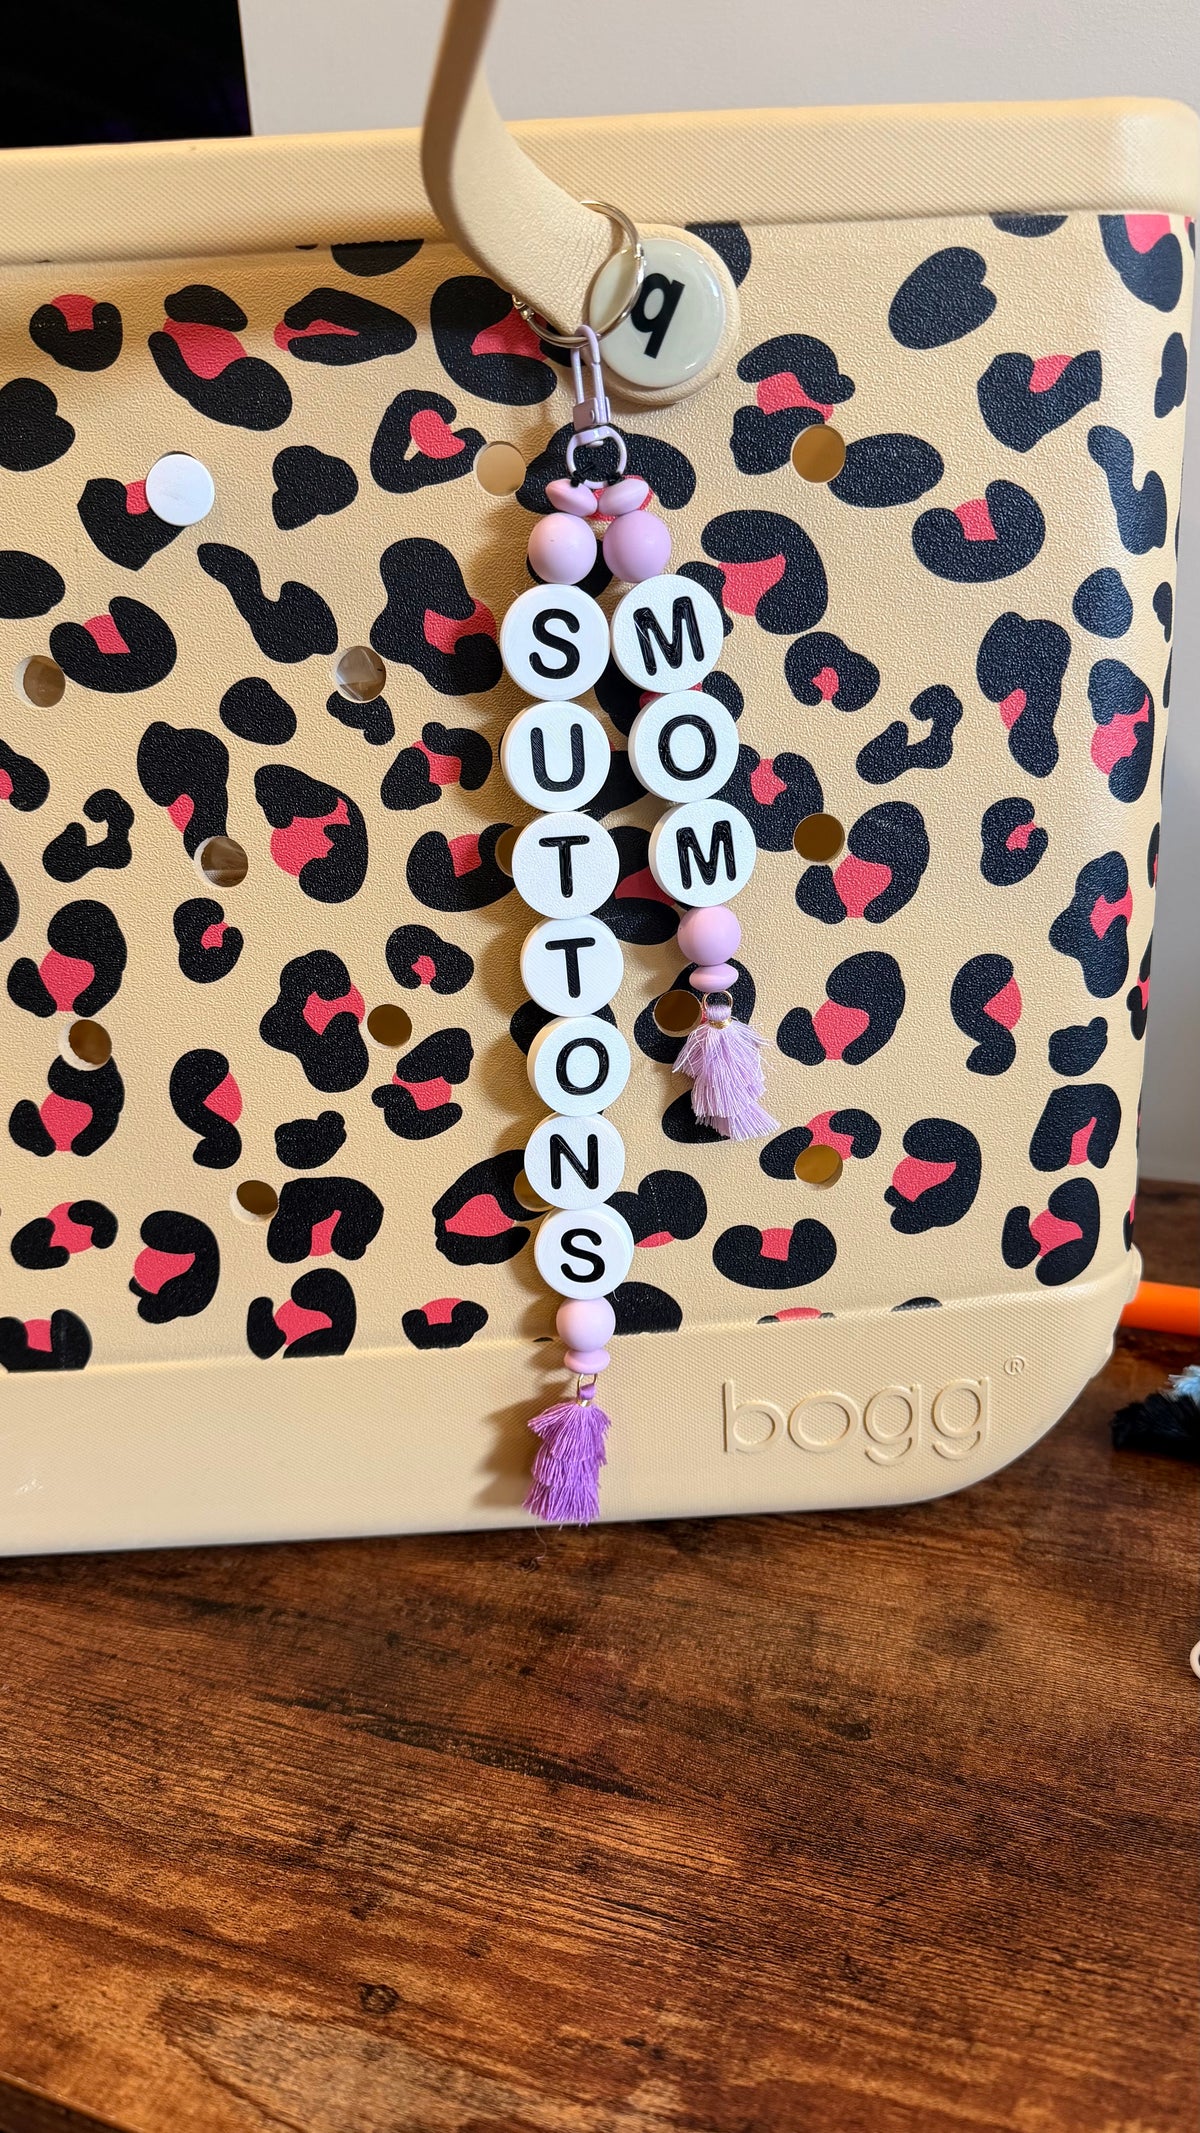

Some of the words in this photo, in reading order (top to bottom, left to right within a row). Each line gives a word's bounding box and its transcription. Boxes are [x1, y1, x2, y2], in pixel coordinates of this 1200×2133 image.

[633, 596, 737, 889] MOM
[529, 608, 610, 1283] SUTTONS
[722, 1376, 990, 1466] bogg
